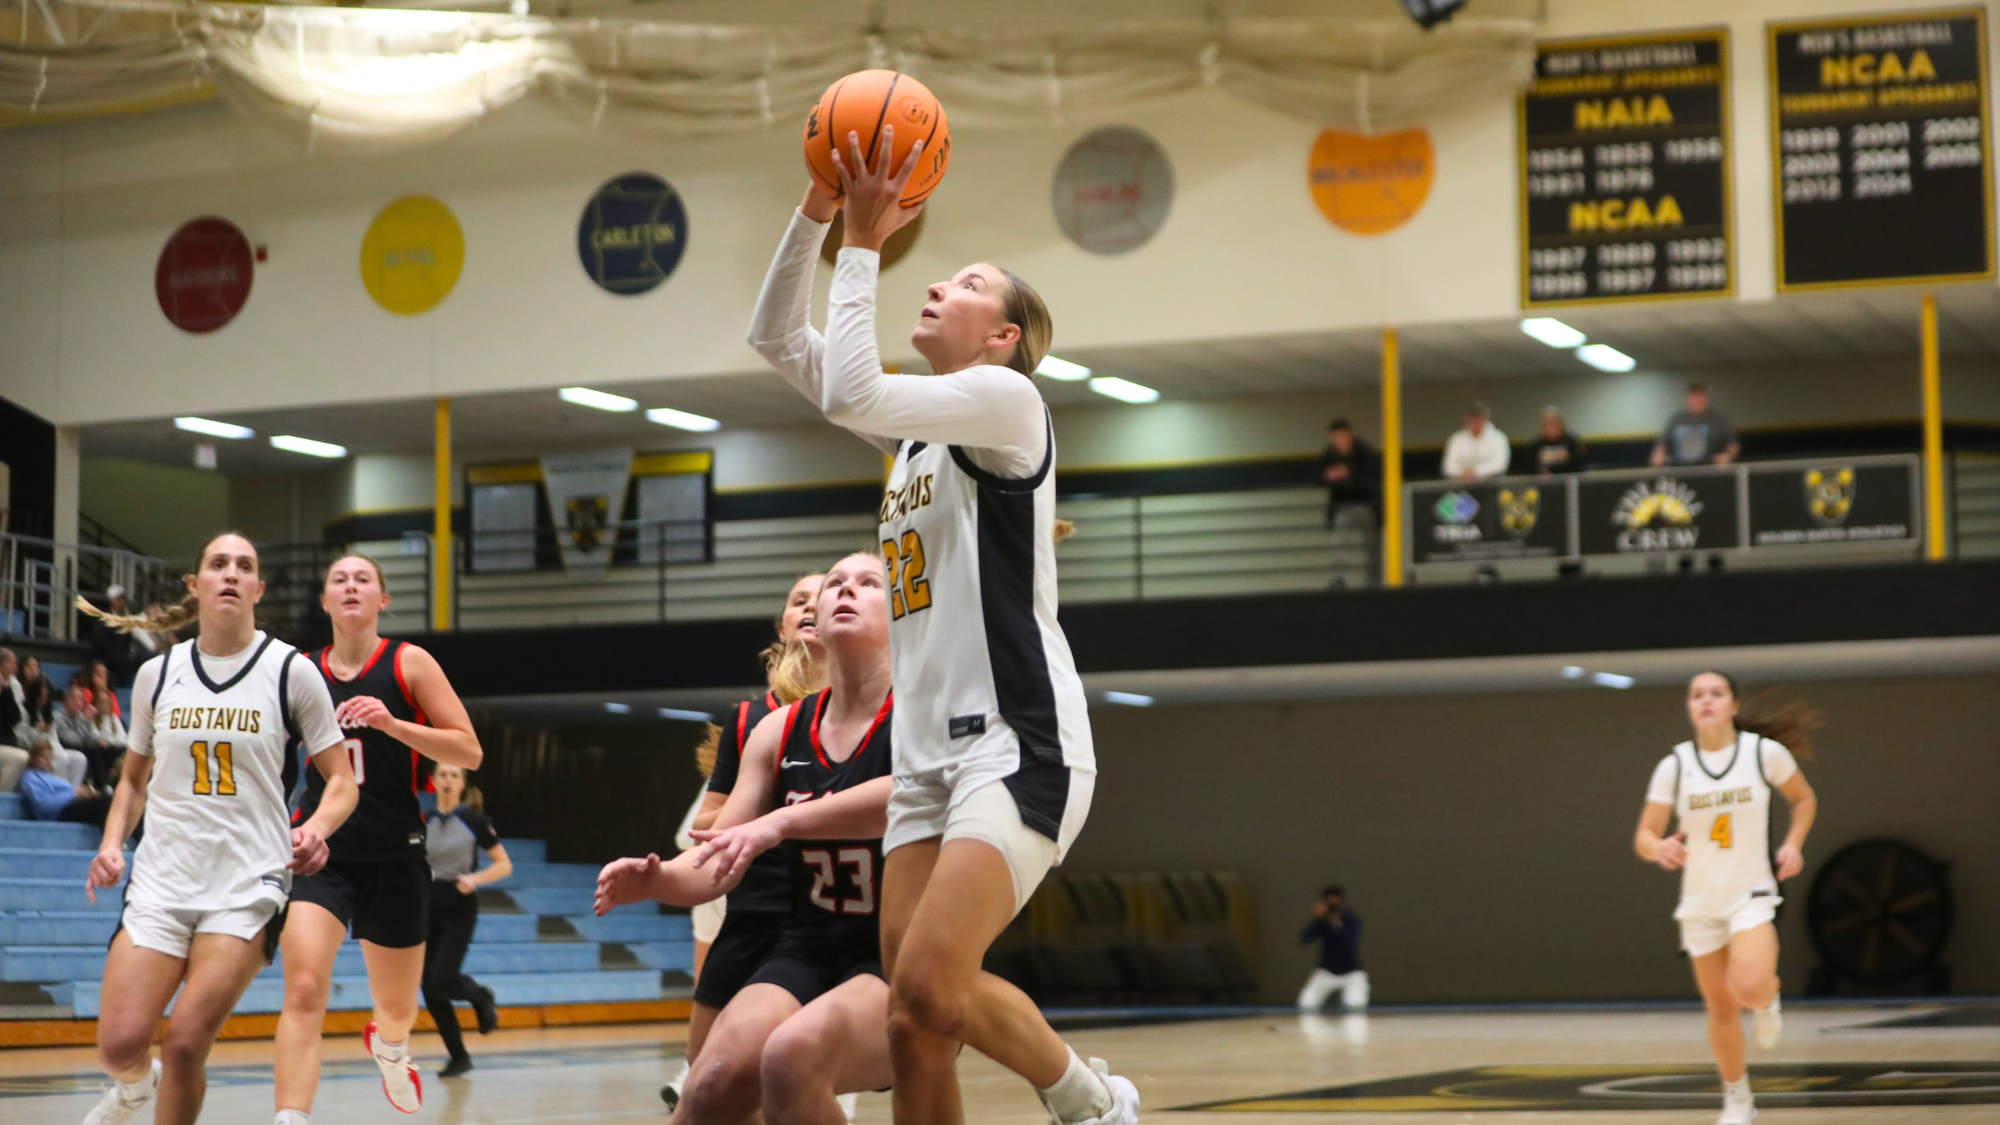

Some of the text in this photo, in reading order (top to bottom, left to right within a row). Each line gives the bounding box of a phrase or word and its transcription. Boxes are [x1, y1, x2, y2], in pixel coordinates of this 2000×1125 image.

[1822, 49, 1936, 85] NCAA
[1574, 96, 1672, 129] NAIA
[1853, 122, 1909, 147] 2001
[1924, 117, 1980, 143] 2002
[1784, 172, 1911, 203] 2012 2024
[1569, 196, 1683, 231] NCAA
[590, 221, 675, 248] CARLETON
[1616, 526, 1699, 550] CREW
[882, 528, 932, 621] 22
[170, 708, 260, 733] GUSTAVUS
[190, 741, 236, 795] 11
[1688, 786, 1752, 810] GUSTAVUS
[1710, 813, 1732, 849] 4
[801, 847, 874, 914] 23
